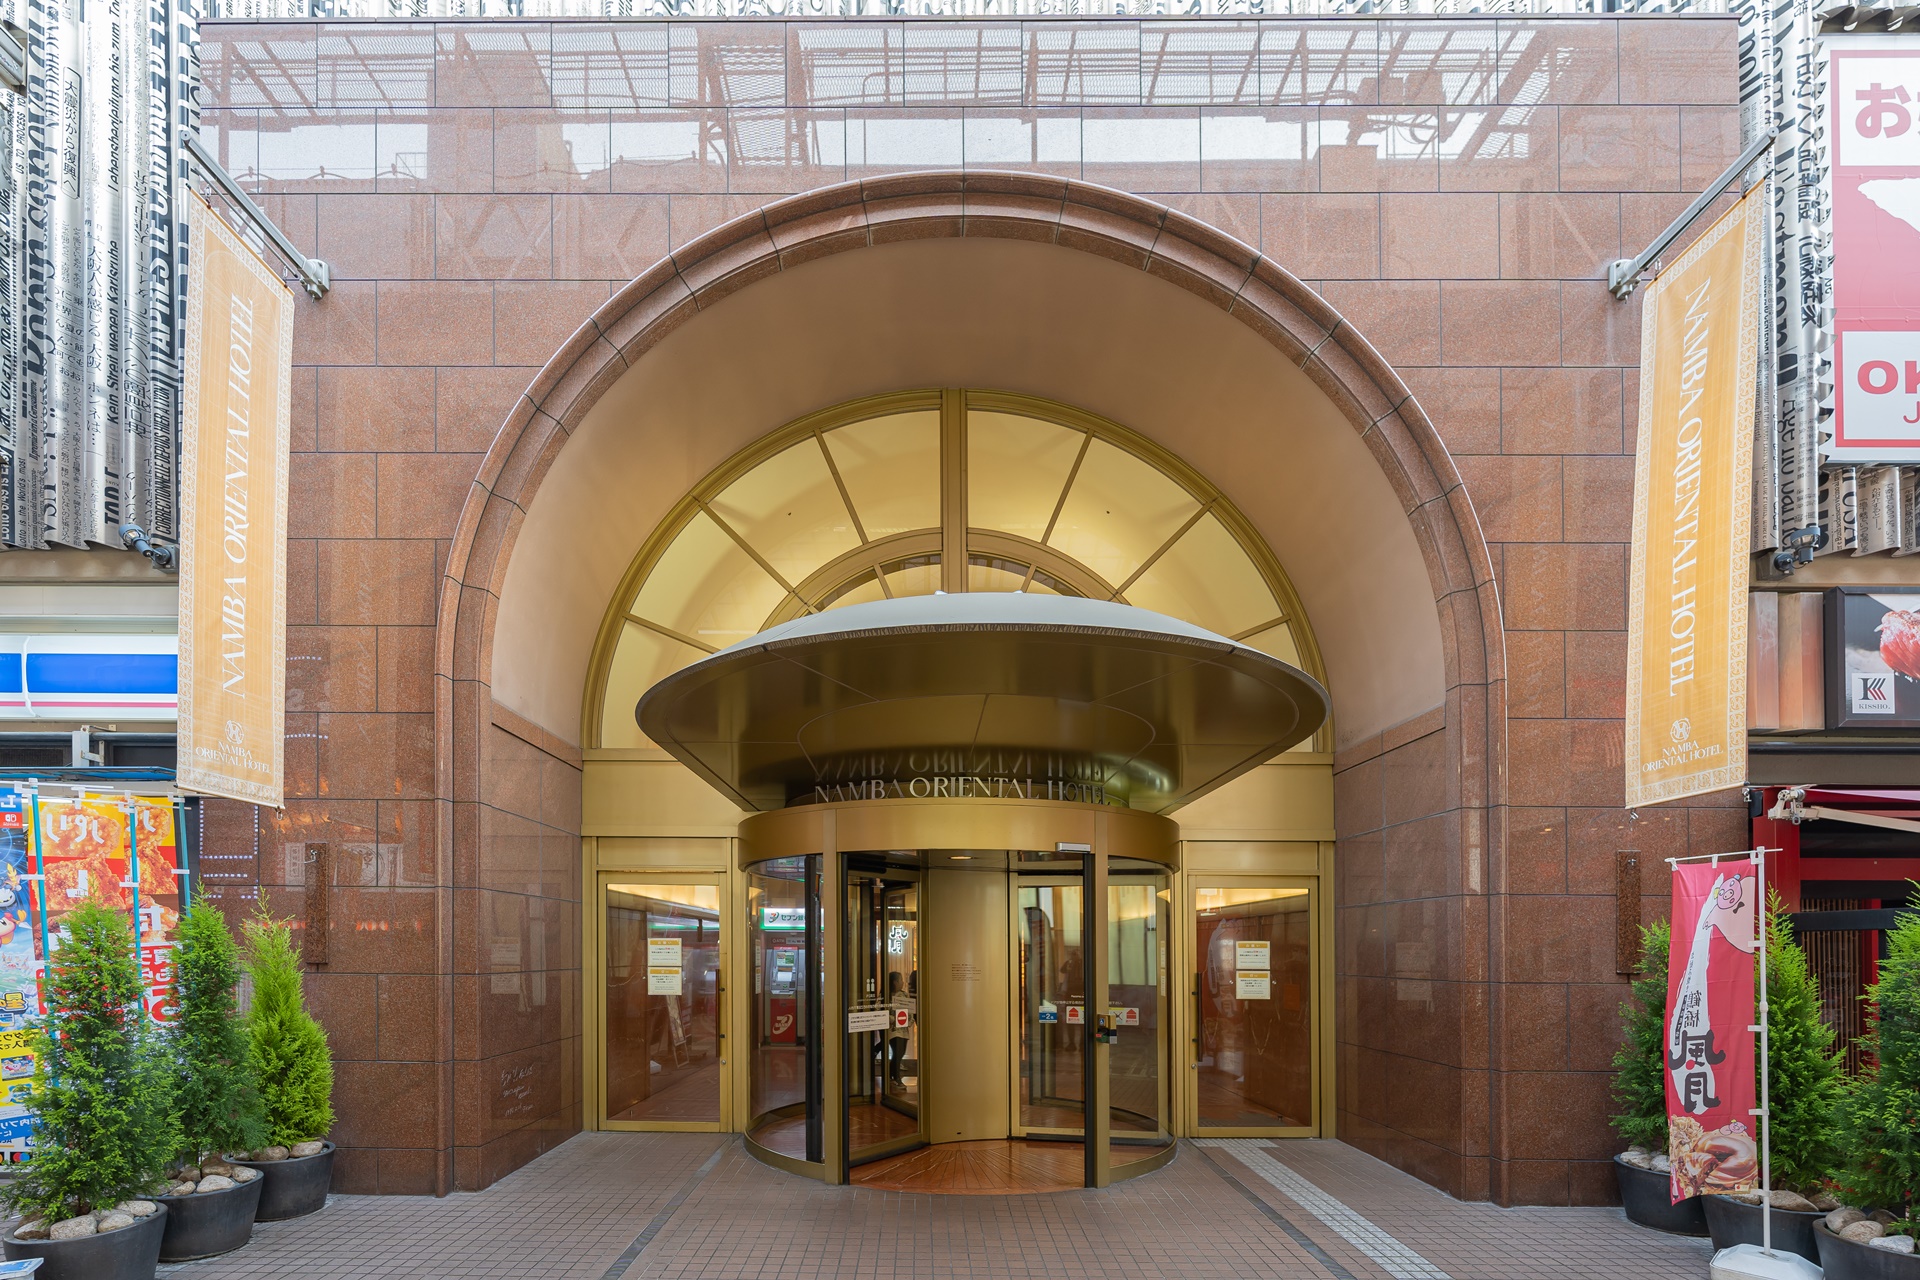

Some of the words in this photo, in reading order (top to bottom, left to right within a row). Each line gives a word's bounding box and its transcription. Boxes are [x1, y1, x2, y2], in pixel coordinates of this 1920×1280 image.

[15, 111, 26, 145] PROCESS
[15, 163, 24, 174] US
[16, 149, 24, 159] TO
[229, 292, 254, 400] HOTEL
[1678, 276, 1711, 419] NAMBA
[152, 384, 170, 406] LYON
[154, 415, 170, 432] HIER
[154, 432, 171, 462] DEPUIS
[17, 457, 26, 474] most
[17, 478, 26, 501] World's
[154, 463, 172, 535] CORRECTIONNELLE
[223, 406, 250, 564] ORIENTAL
[18, 506, 26, 517] the
[1672, 417, 1703, 585] ORIENTAL
[18, 530, 27, 547] Lotto
[222, 575, 247, 700] NAMBA
[1670, 584, 1697, 697] HOTEL
[195, 746, 241, 767] ORIENTAL
[243, 759, 272, 775] HOTEL
[218, 741, 253, 759] NAMBA
[1642, 752, 1688, 773] ORIENTAL
[1689, 744, 1723, 761] HOTEL
[1662, 741, 1699, 758] NAMBA
[815, 779, 904, 804] NAMBA
[909, 776, 1040, 800] ORIENTAL
[1048, 780, 1111, 806] HOTEL
[781, 913, 805, 921] セブン銀
